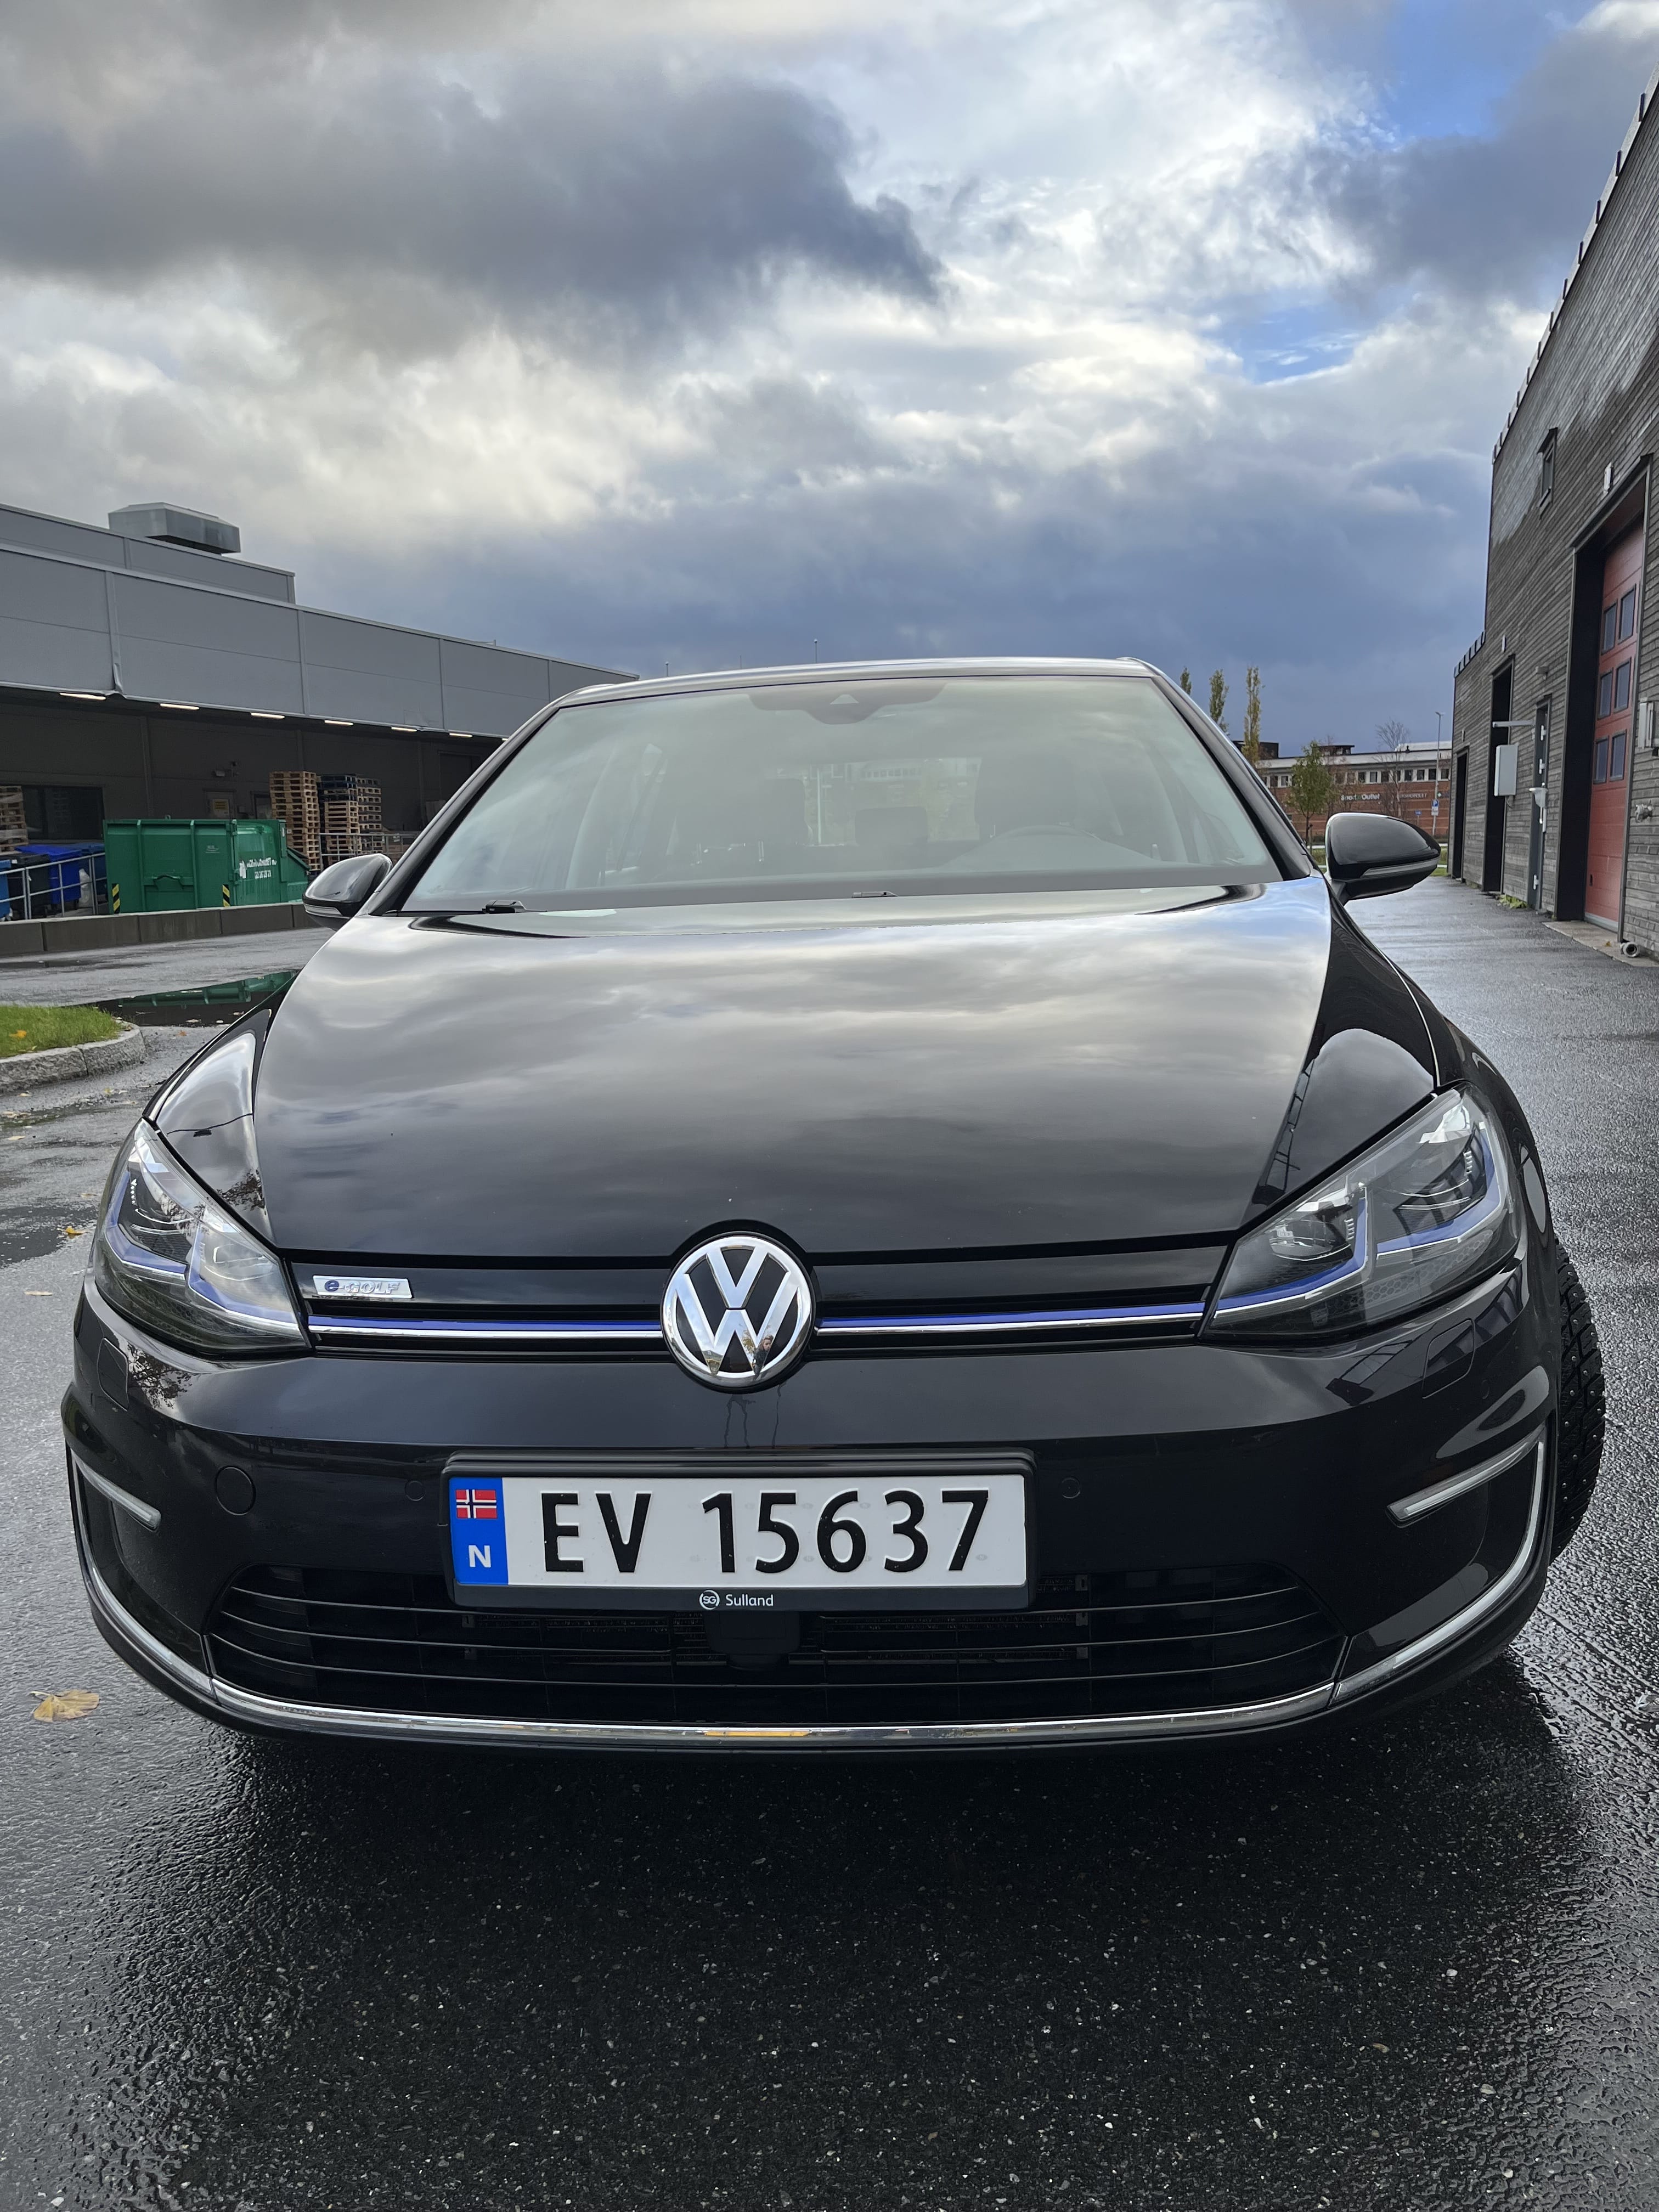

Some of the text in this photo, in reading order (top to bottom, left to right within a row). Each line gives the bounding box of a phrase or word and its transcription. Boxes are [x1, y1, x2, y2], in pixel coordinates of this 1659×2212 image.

[324, 1280, 400, 1294] e-GOLF
[541, 1490, 989, 1573] EV 15637
[468, 1544, 492, 1568] N
[725, 1593, 774, 1607] Sulland
